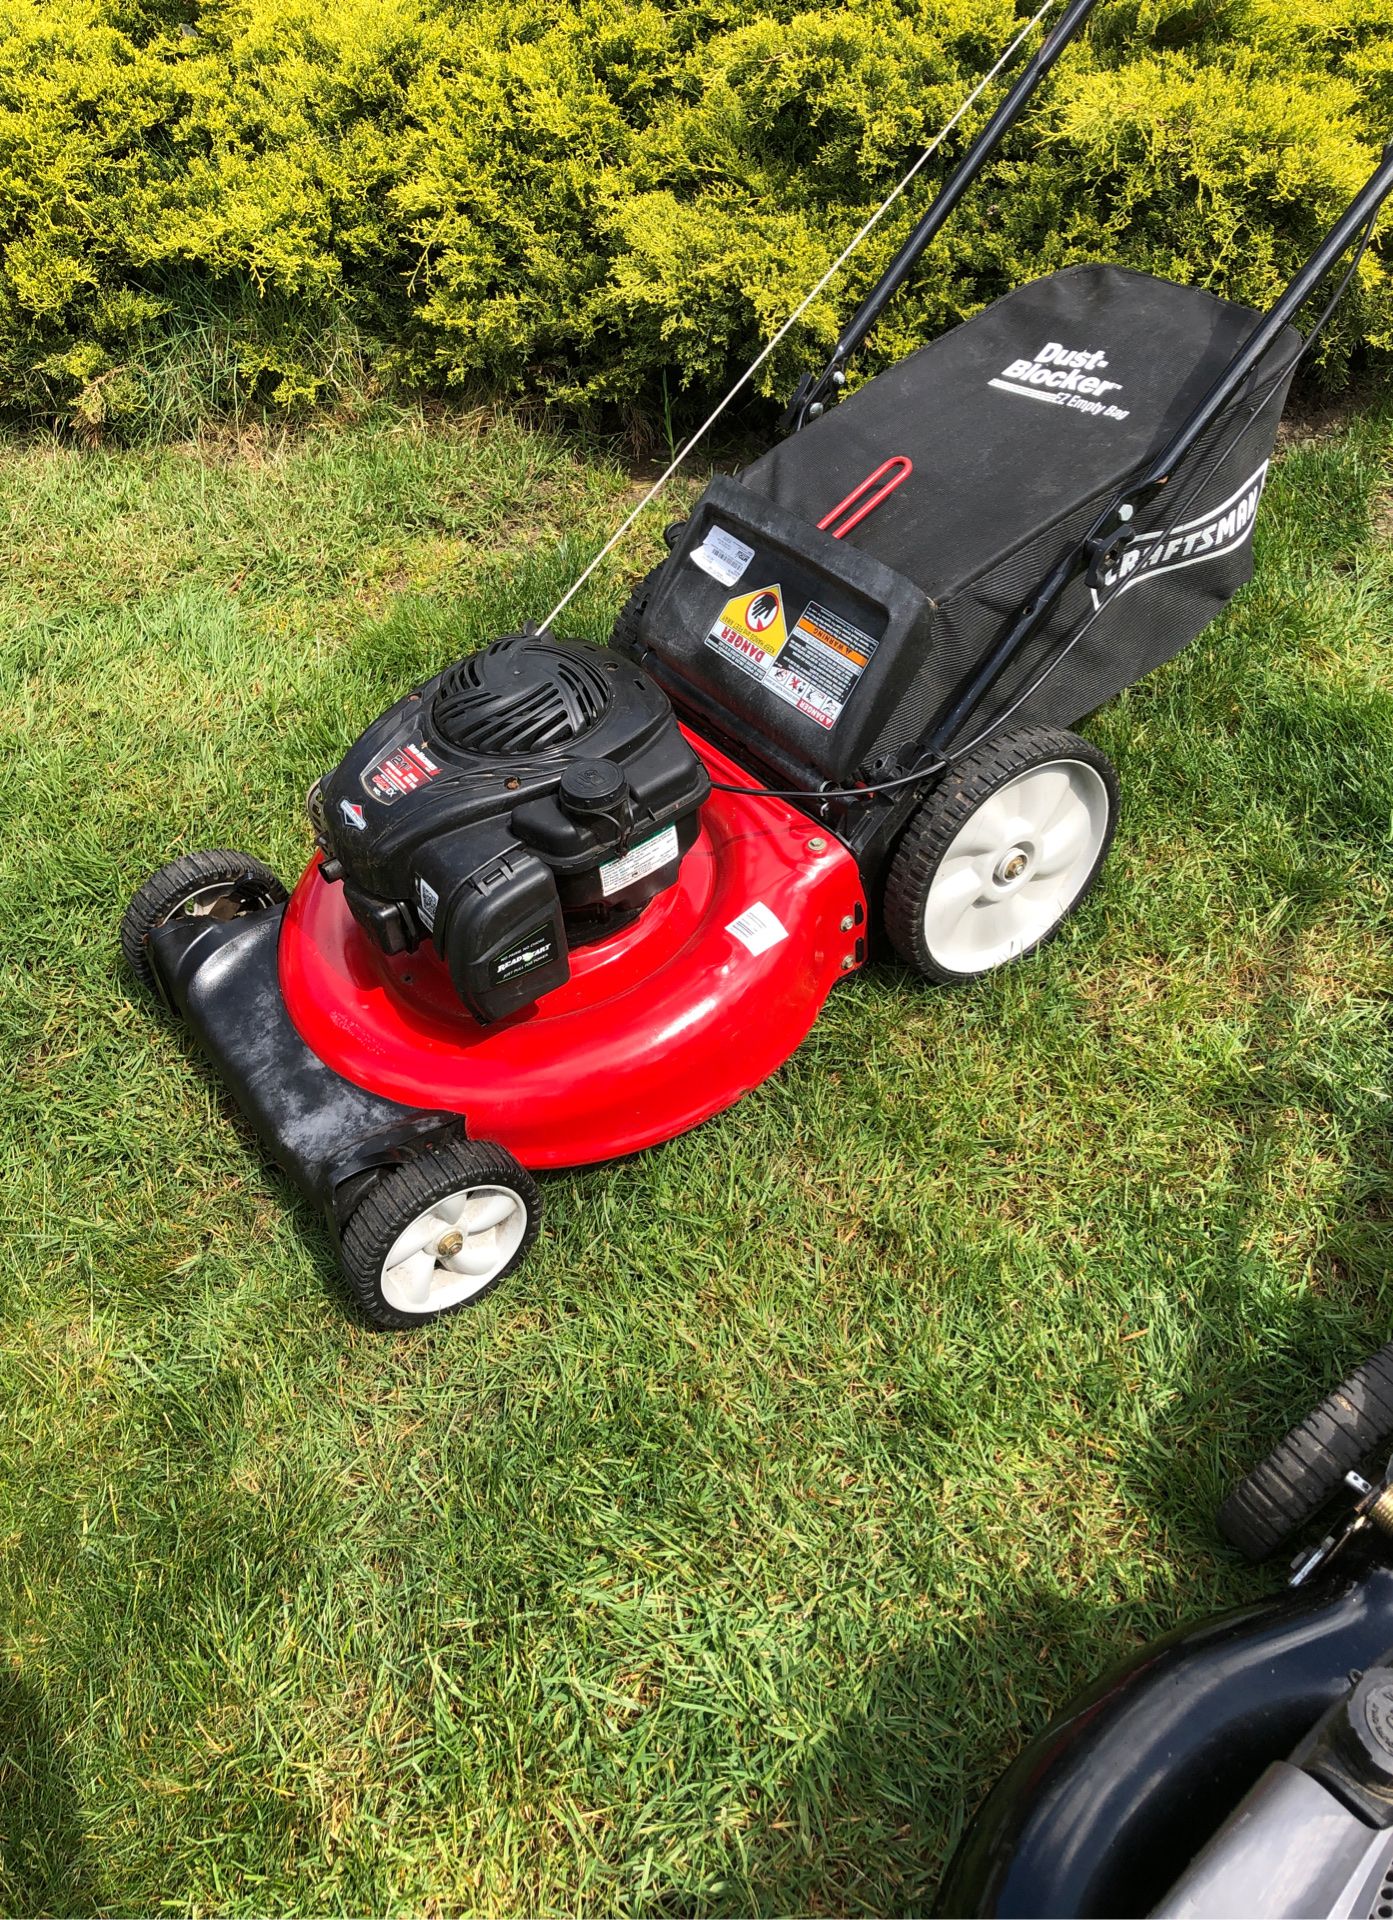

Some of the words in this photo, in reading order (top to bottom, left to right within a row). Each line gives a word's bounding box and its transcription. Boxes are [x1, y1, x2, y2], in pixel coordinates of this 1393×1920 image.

[1033, 342, 1109, 370] Dust-
[1066, 395, 1106, 415] Empty
[1103, 405, 1130, 420] Bag
[721, 626, 765, 663] DANGER
[813, 628, 844, 650] WARNING
[799, 700, 825, 721] DANGER
